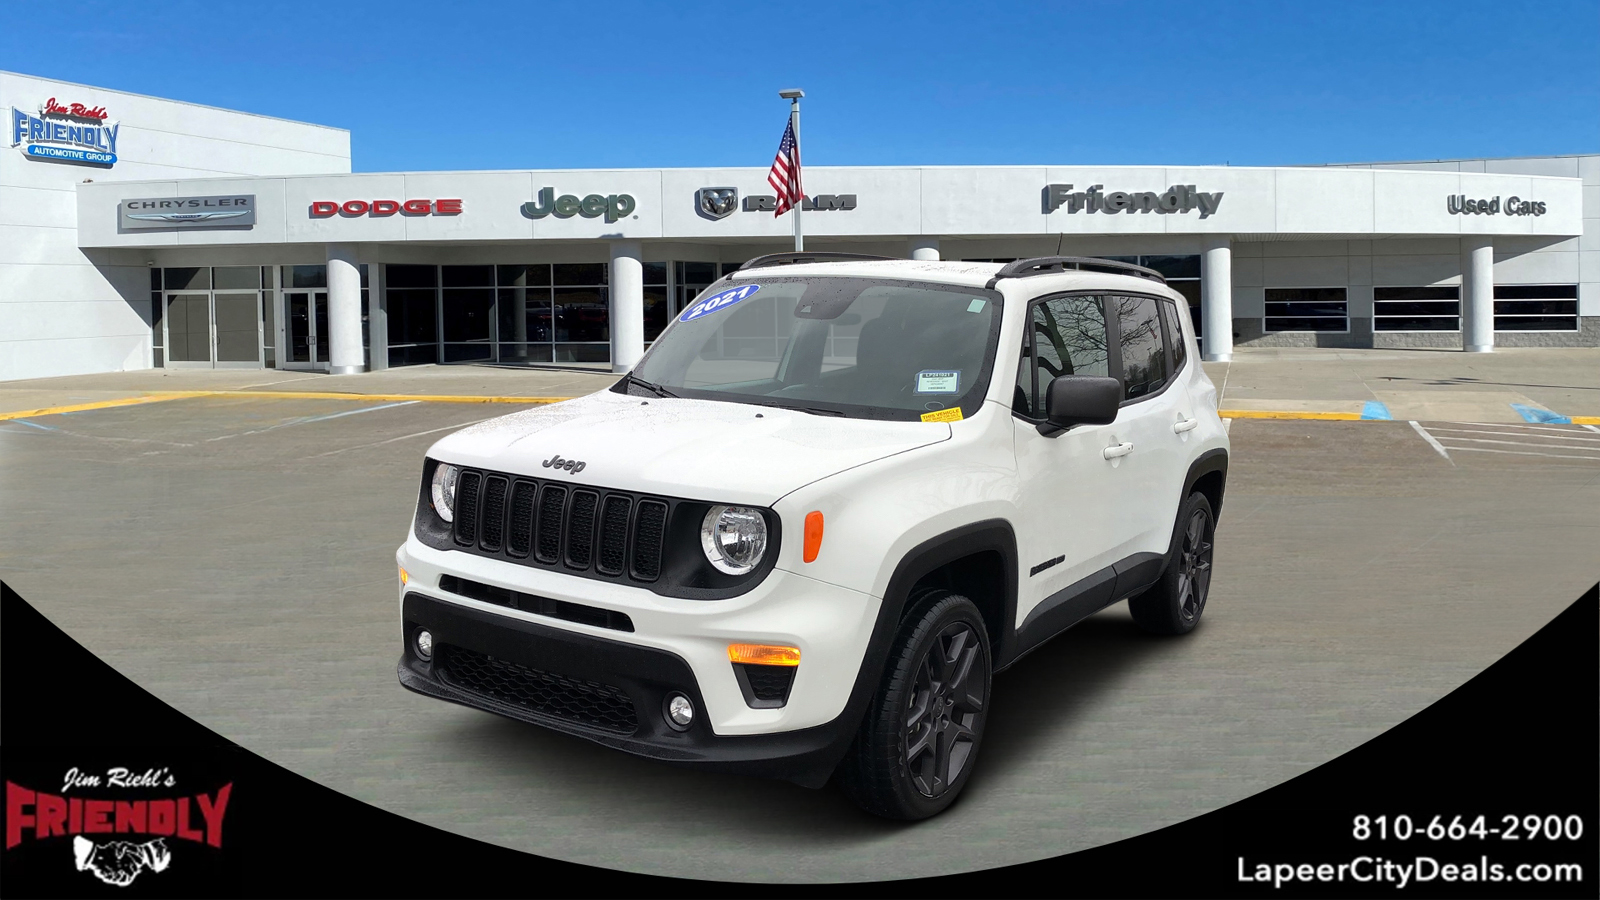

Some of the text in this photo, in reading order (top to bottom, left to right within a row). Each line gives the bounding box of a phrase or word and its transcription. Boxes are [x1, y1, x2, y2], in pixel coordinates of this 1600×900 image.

[44, 97, 109, 120] Jim Riehl's
[12, 106, 120, 153] FRIENDLY
[34, 148, 113, 162] AUTOMOTIVE GROUP
[127, 199, 248, 210] CHRYSLER
[311, 198, 463, 216] DODGE
[522, 186, 636, 222] Jeep
[1042, 184, 1225, 219] Friendly
[1447, 194, 1547, 216] Used Cars
[687, 286, 751, 320] 2021
[542, 454, 587, 475] Jeep
